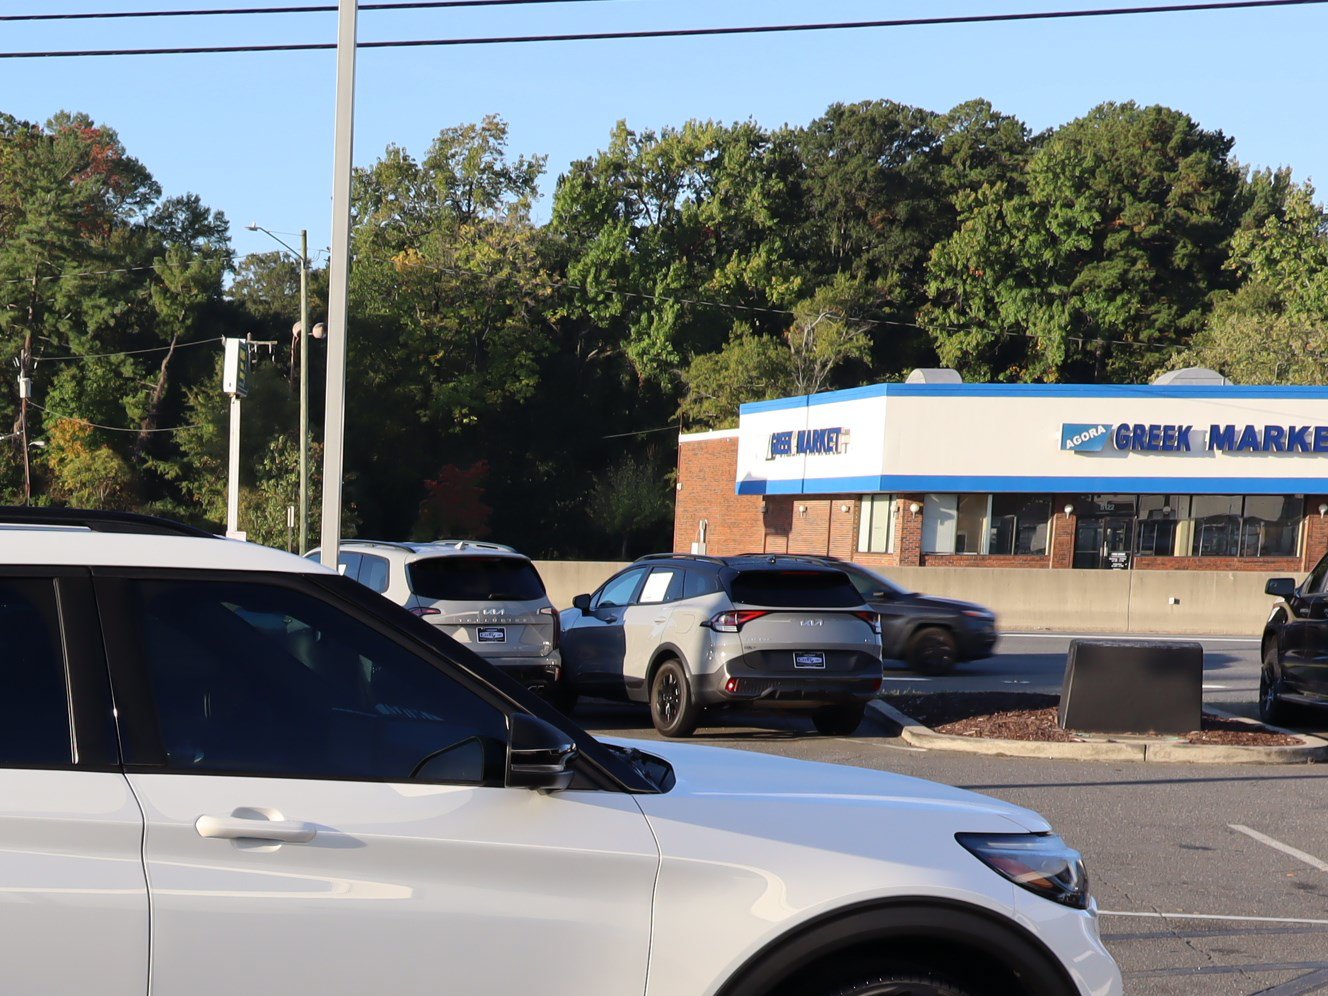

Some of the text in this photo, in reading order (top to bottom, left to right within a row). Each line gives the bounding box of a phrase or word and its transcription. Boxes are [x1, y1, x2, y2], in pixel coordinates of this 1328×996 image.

[796, 427, 842, 454] MARKET
[1066, 423, 1328, 452] AGORA GREEK MARKE
